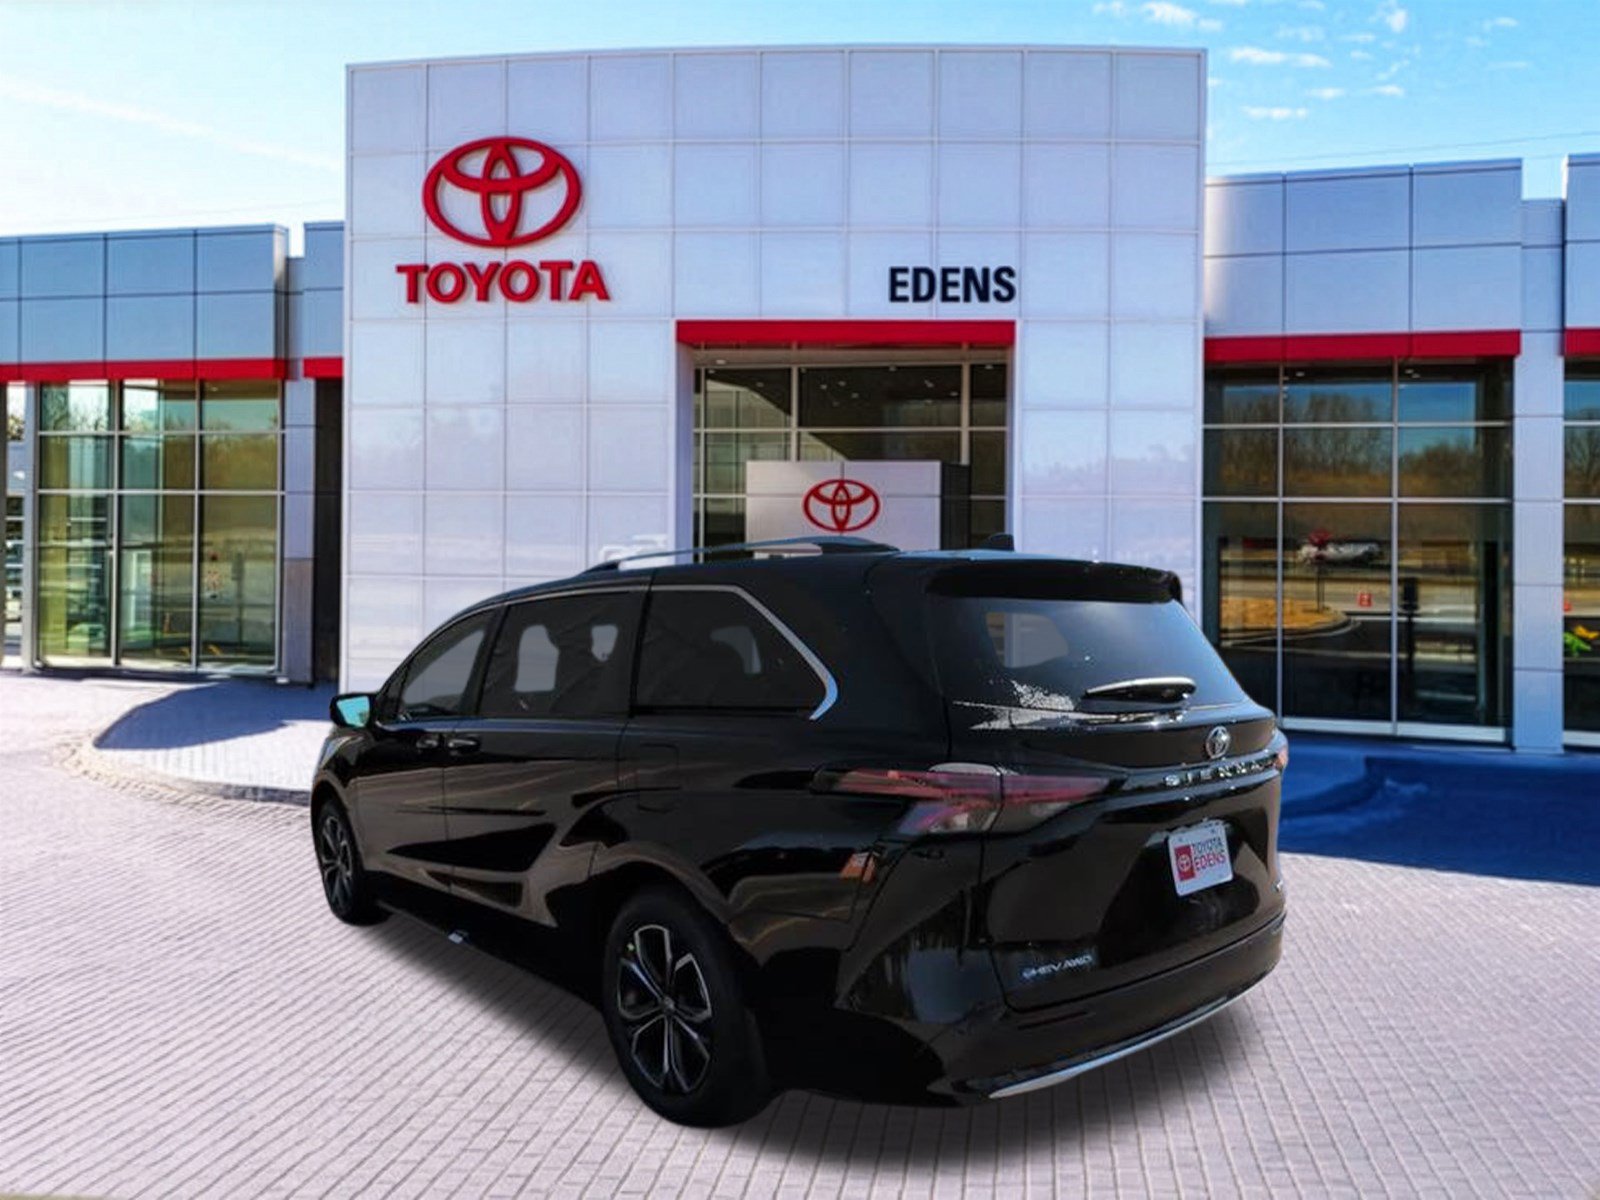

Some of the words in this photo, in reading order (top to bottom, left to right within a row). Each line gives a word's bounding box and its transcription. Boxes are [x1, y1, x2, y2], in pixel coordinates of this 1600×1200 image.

[395, 259, 611, 304] TOYOTA
[888, 265, 1017, 303] EDENS
[1192, 836, 1226, 855] TOYOTA
[1193, 852, 1228, 872] EDENS
